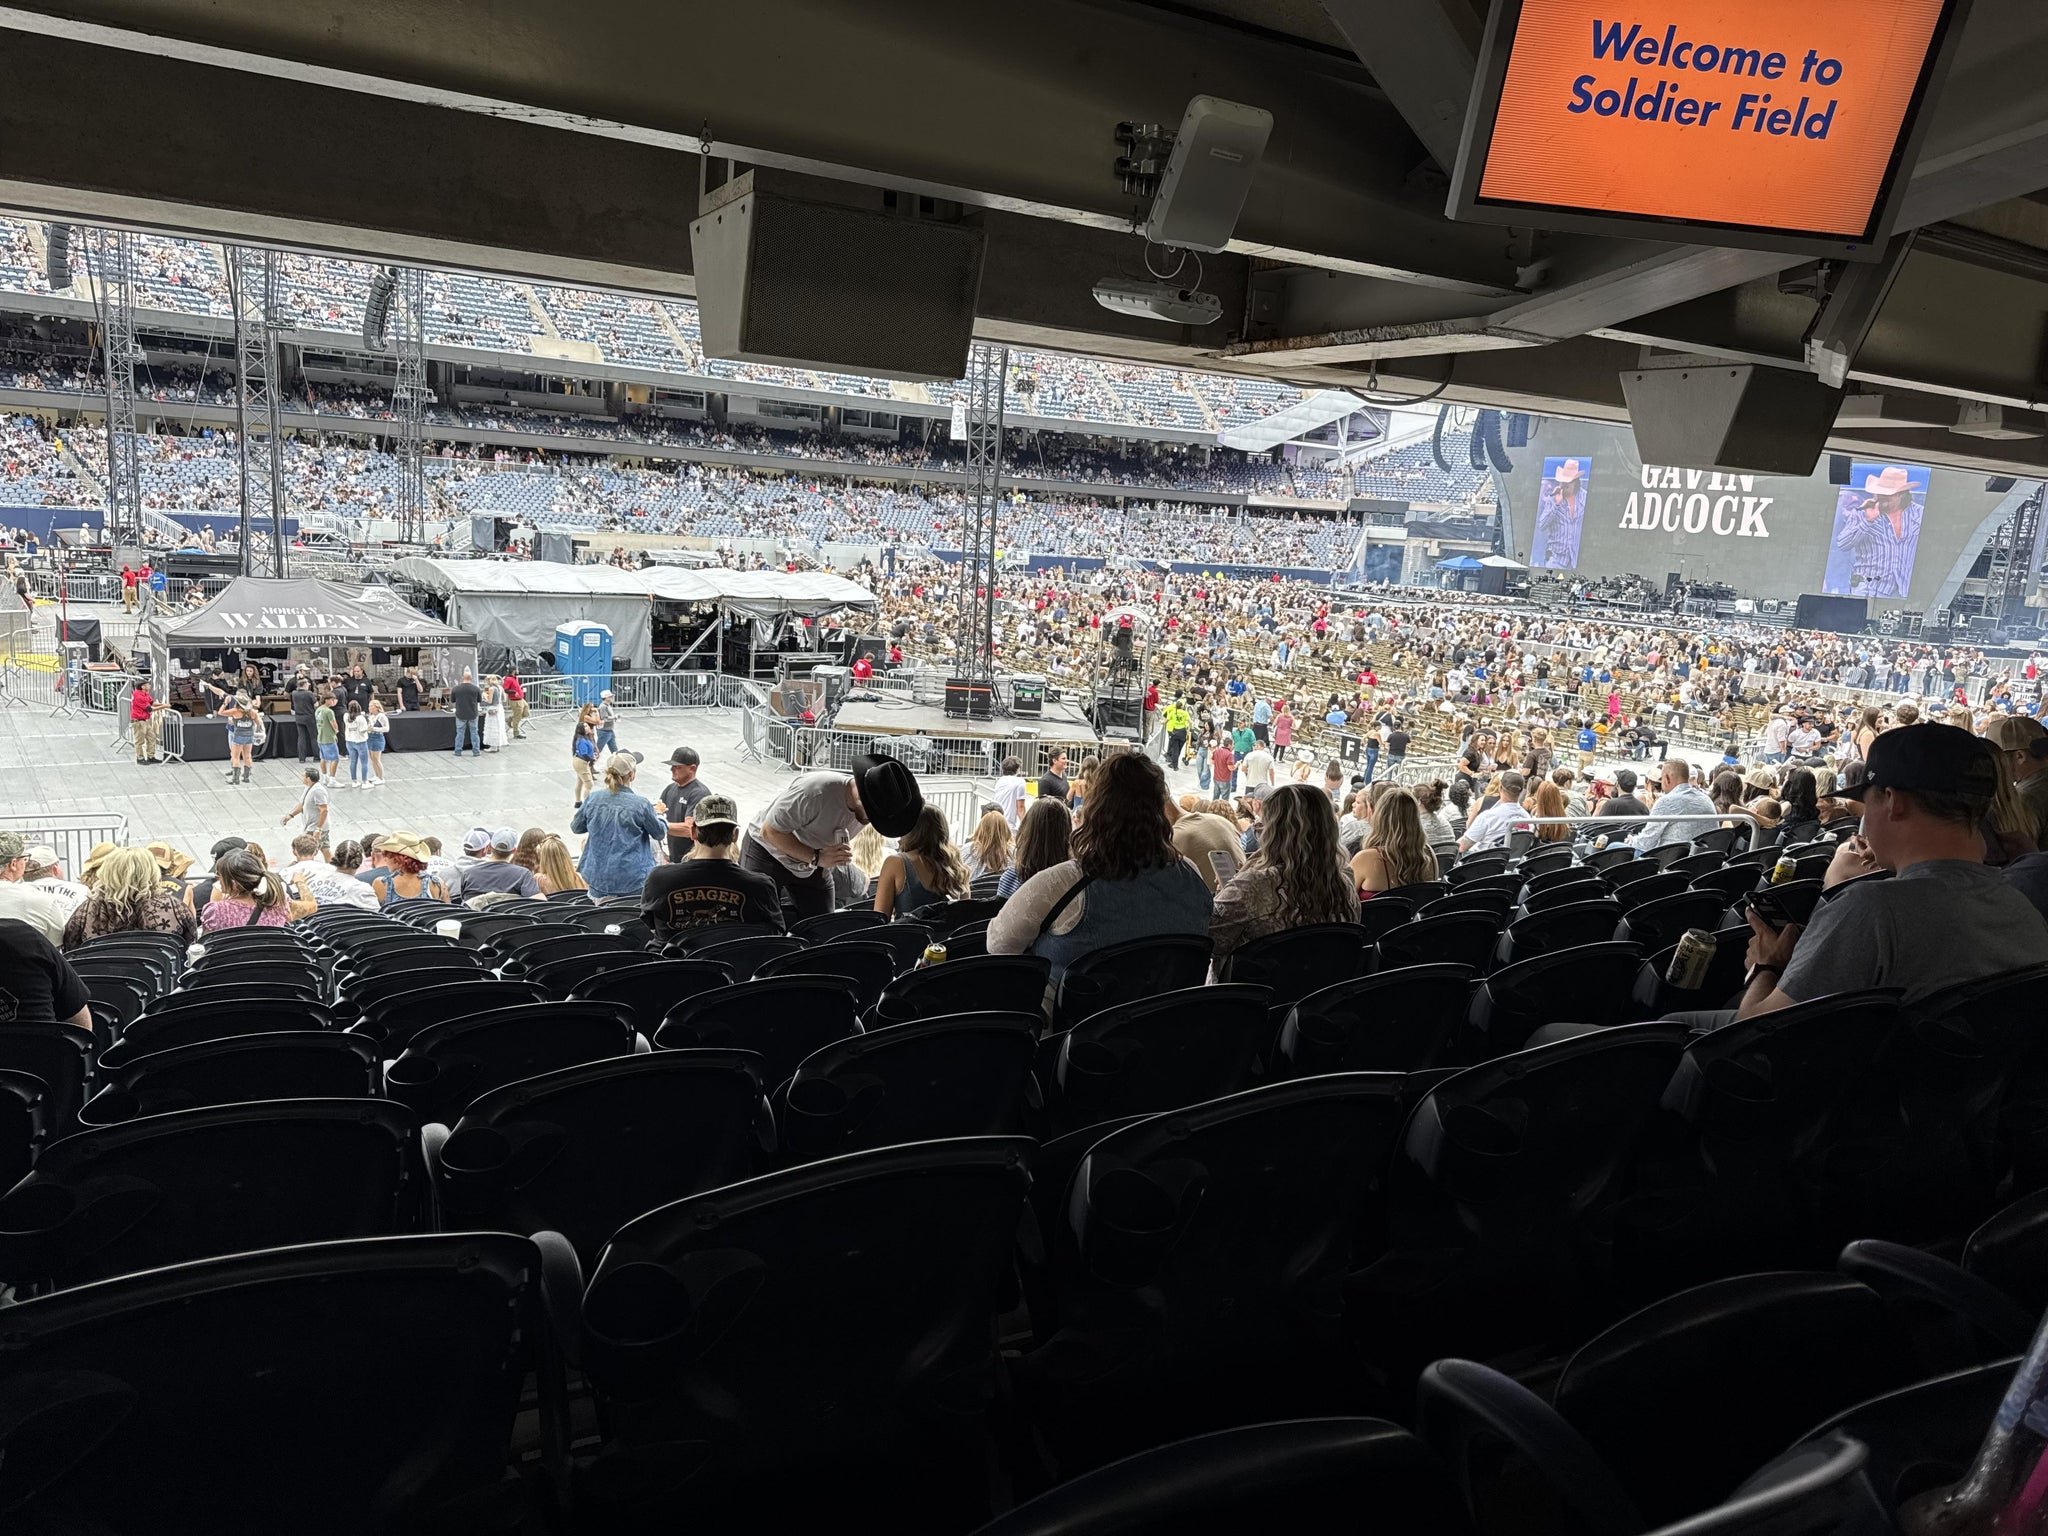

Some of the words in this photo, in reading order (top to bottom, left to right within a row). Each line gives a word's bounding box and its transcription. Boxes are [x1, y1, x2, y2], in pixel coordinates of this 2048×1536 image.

[1590, 19, 1787, 80] Welcome
[1800, 48, 1843, 87] to
[1567, 75, 1721, 127] Soldier
[1732, 94, 1838, 140] Field
[1618, 491, 1774, 538] ADCOCK
[261, 606, 318, 615] MORGAN
[218, 612, 361, 629] WALLEN
[223, 635, 260, 645] STILL
[264, 635, 287, 645] THE
[290, 635, 347, 645] PROBLEM
[390, 636, 421, 645] TOUR
[424, 637, 449, 645] 2026
[1668, 714, 1680, 730] A
[1345, 740, 1356, 757] F
[43, 886, 55, 894] IN
[58, 886, 77, 899] THE
[310, 879, 347, 897] MORGAN
[673, 889, 741, 906] SEAGER
